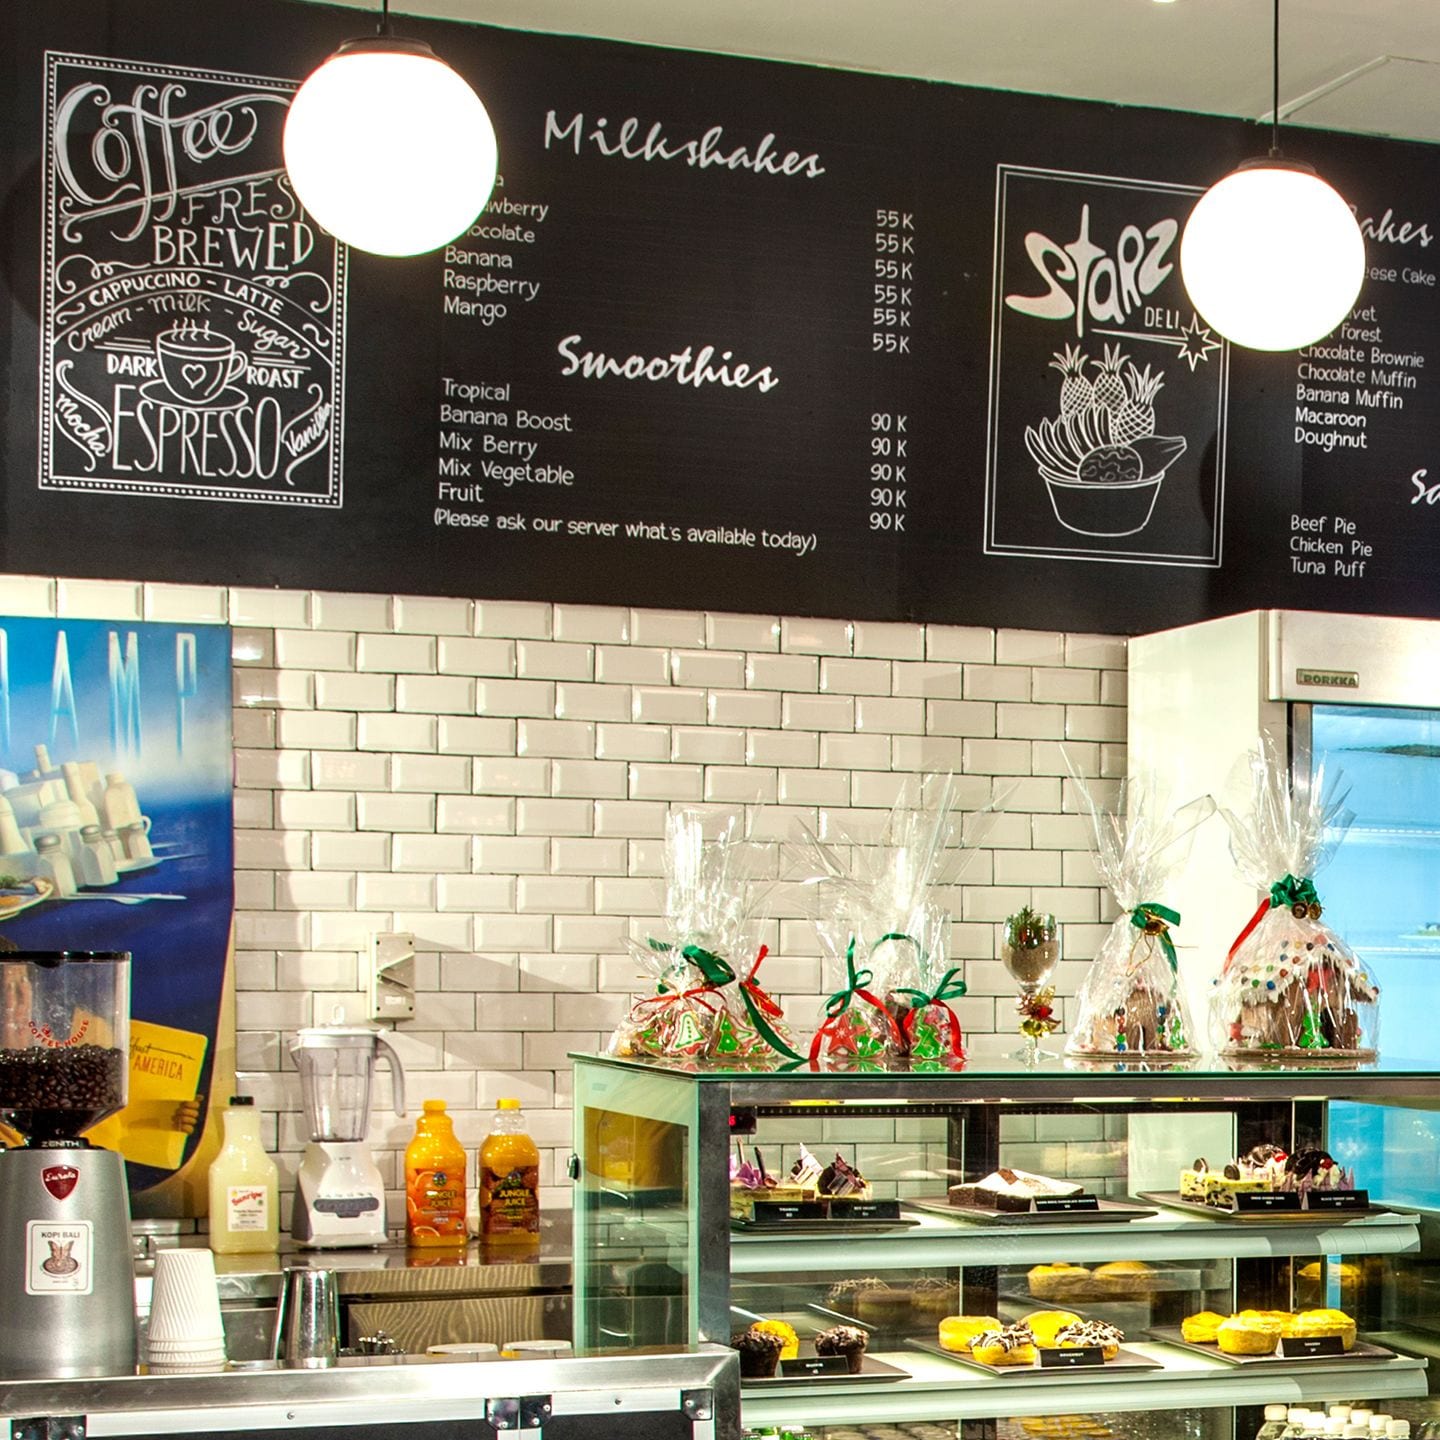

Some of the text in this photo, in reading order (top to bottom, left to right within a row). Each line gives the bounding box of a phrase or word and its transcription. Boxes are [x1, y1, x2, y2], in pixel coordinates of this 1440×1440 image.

[545, 110, 825, 178] Milkshakes
[55, 82, 258, 241] Coffee
[179, 174, 304, 232] FRES
[487, 197, 549, 222] wberry
[467, 223, 536, 243] ocolate
[1361, 208, 1433, 248] akes
[153, 222, 314, 271] BREWED
[443, 244, 512, 271] Banana
[444, 269, 540, 303] Raspberry
[1366, 267, 1436, 286] ese Cake
[88, 272, 284, 315] CAPPUCCINO LATTE
[444, 294, 507, 326] Mango
[1145, 307, 1182, 330] DELI
[1350, 305, 1378, 322] vet
[68, 308, 133, 352] Cream
[237, 310, 311, 359] Sugar
[1341, 323, 1382, 342] Forest
[106, 354, 304, 389] DARK ROAST
[558, 335, 779, 392] Smoothies
[1371, 347, 1424, 370] Brownie
[1297, 360, 1416, 388] Chocolate Muffin
[442, 378, 510, 403] Tropical
[1297, 383, 1403, 409] Banana Muffin
[285, 402, 333, 457] Vanilla
[441, 404, 572, 431] Banana Boost
[1295, 405, 1367, 430] Macaroon
[112, 384, 282, 479] ESPRESSO
[1295, 424, 1367, 452] Doughnut
[440, 431, 537, 463] Mix Berry
[439, 458, 574, 489] Mix Vegetable
[439, 482, 484, 502] Fruit
[434, 508, 816, 556] (Please ask our server what's available today)
[1291, 515, 1356, 535] Beef Pie
[1290, 536, 1372, 557] Chicken Pie
[1290, 556, 1366, 577] Tuna Puff
[132, 1054, 183, 1081] AMERICA
[41, 1140, 80, 1148] ZENITH
